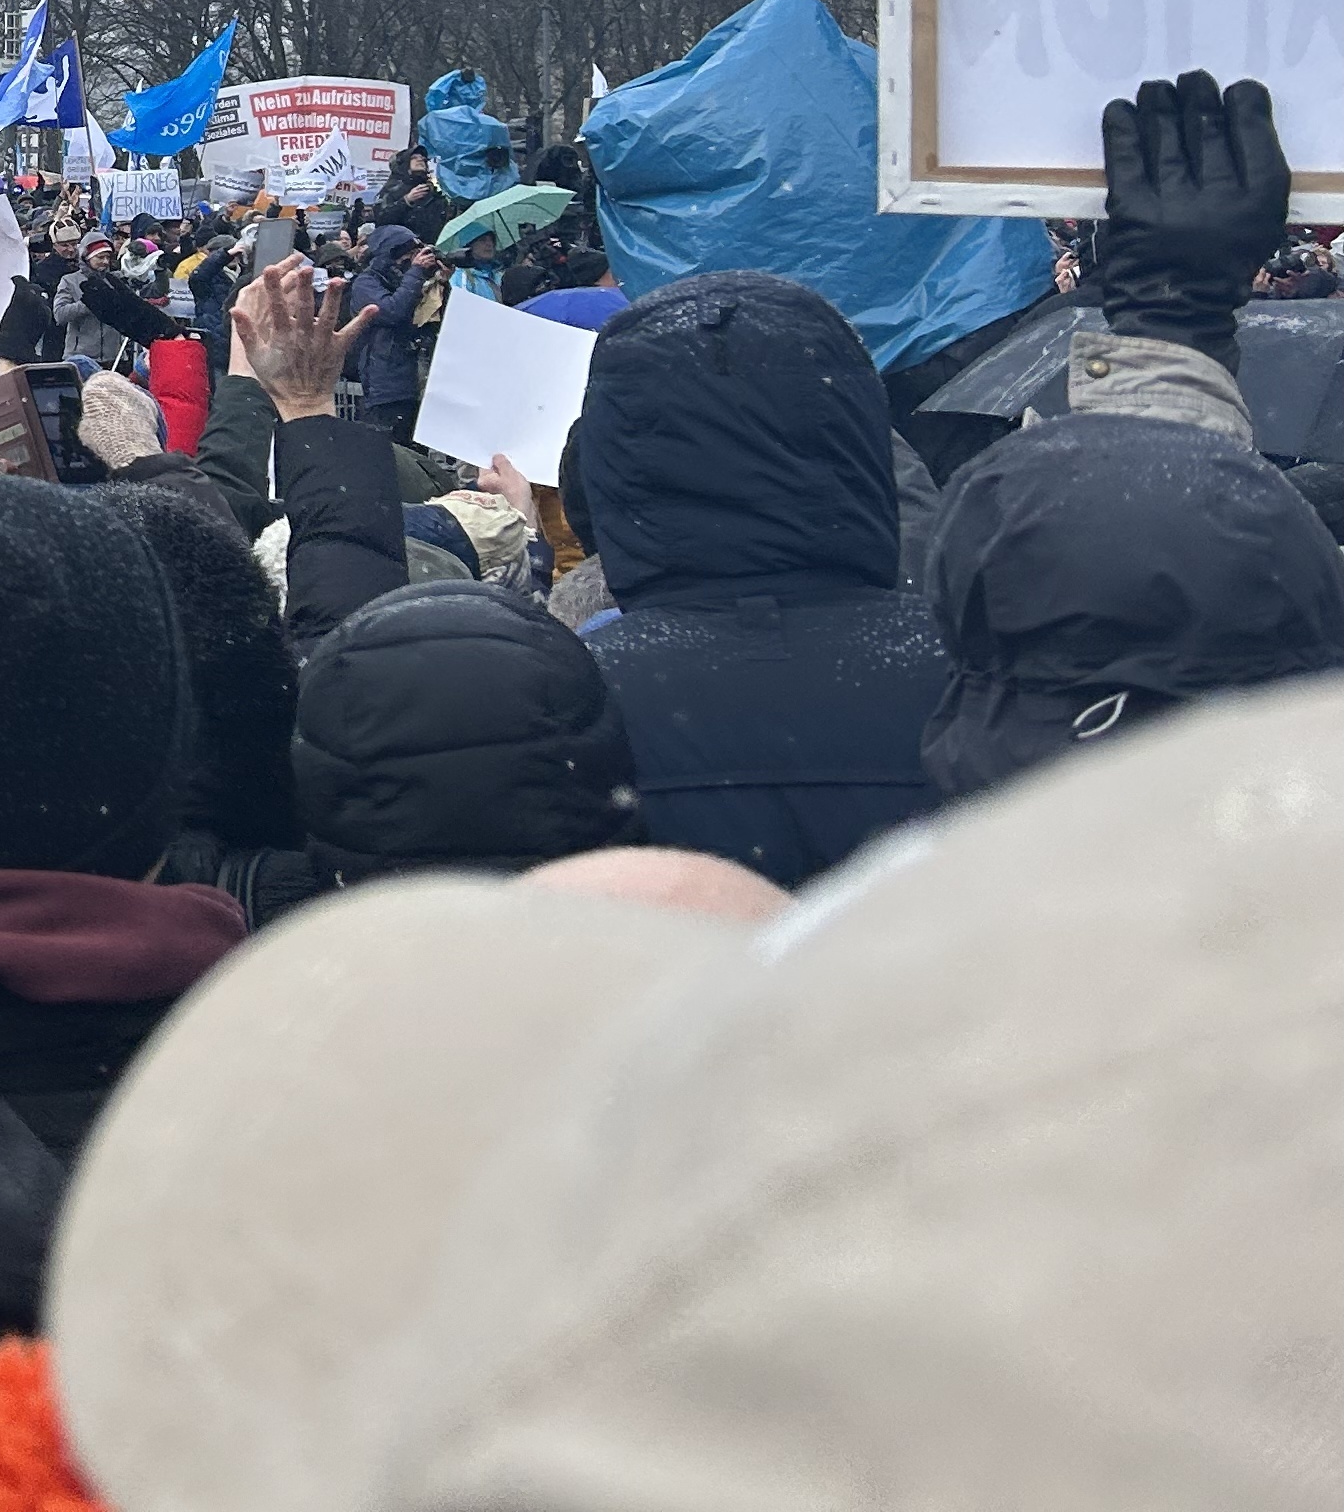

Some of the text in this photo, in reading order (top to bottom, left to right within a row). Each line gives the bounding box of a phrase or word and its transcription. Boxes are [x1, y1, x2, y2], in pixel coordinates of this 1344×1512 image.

[253, 95, 291, 111] Nein
[296, 92, 311, 105] zu
[100, 172, 178, 194] WELTKRIEG
